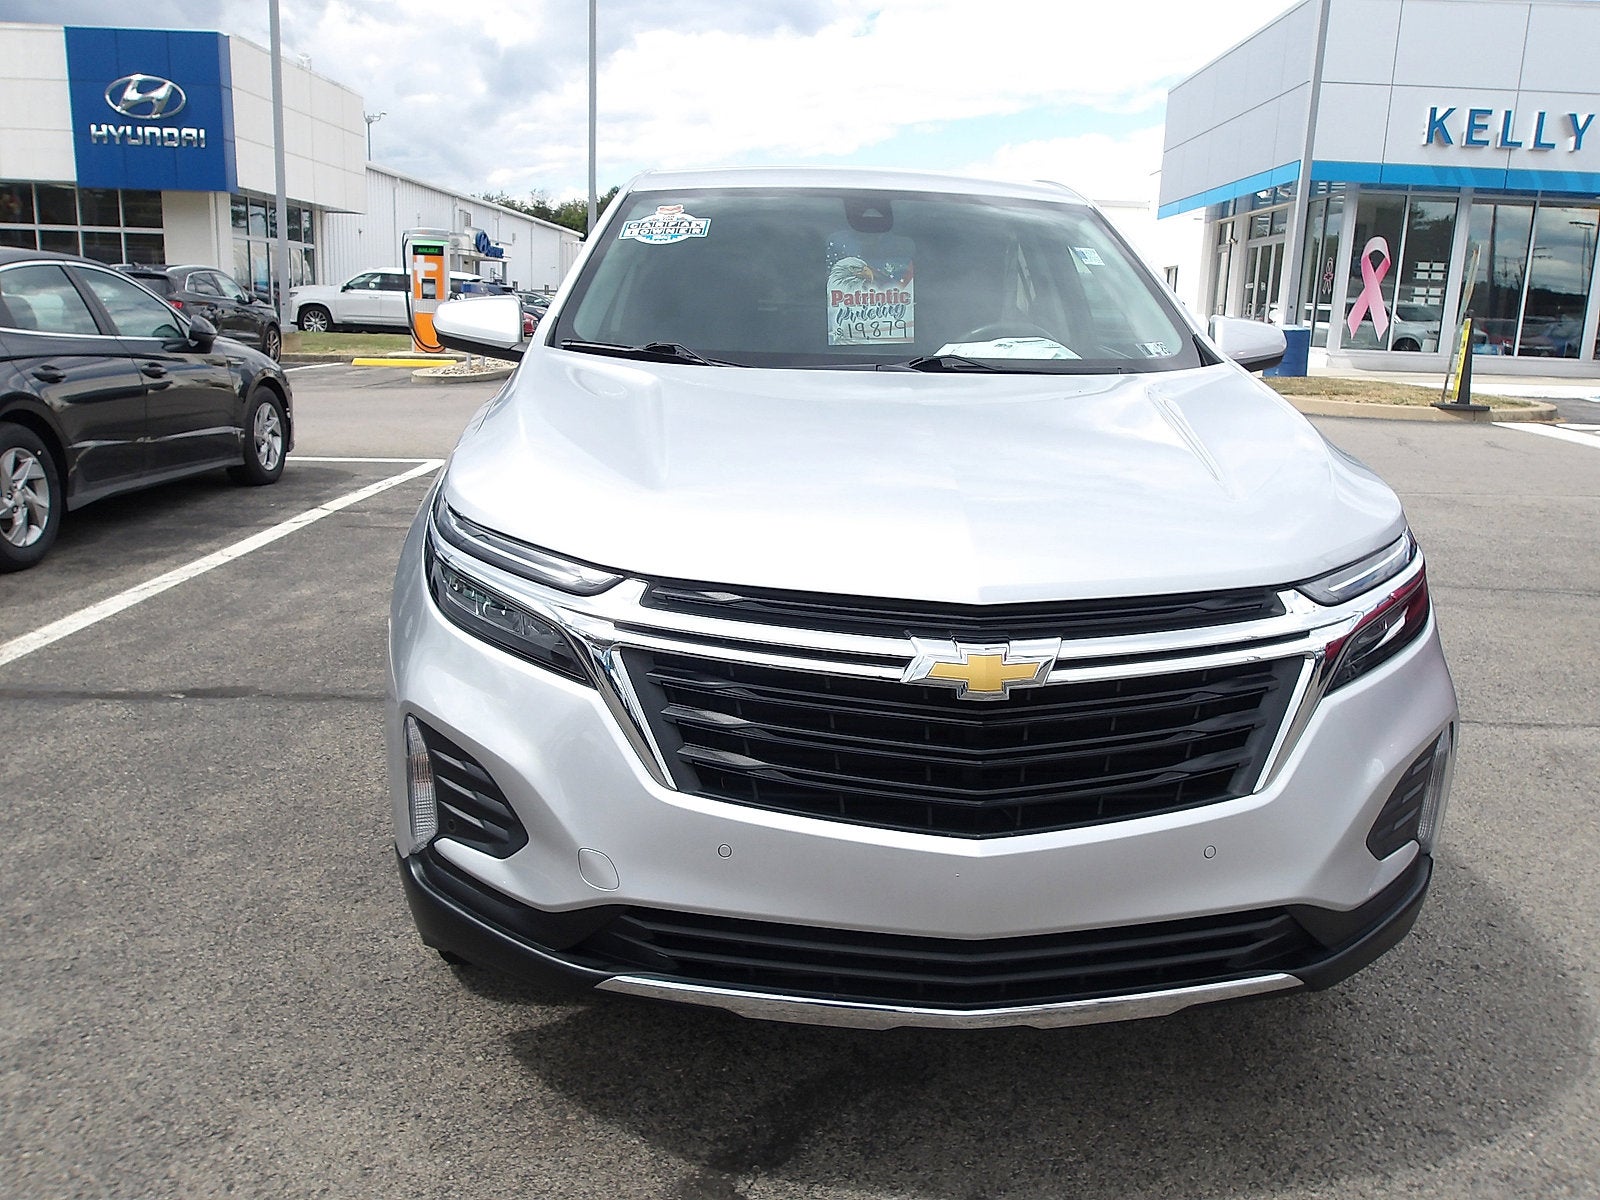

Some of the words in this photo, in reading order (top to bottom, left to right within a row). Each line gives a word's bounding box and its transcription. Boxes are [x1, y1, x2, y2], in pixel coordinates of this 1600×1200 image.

[90, 123, 206, 148] HYUNDAI
[1422, 105, 1596, 152] KELLY
[638, 228, 704, 236] OWNER
[831, 288, 912, 307] Patriotic
[836, 303, 907, 326] Pricing
